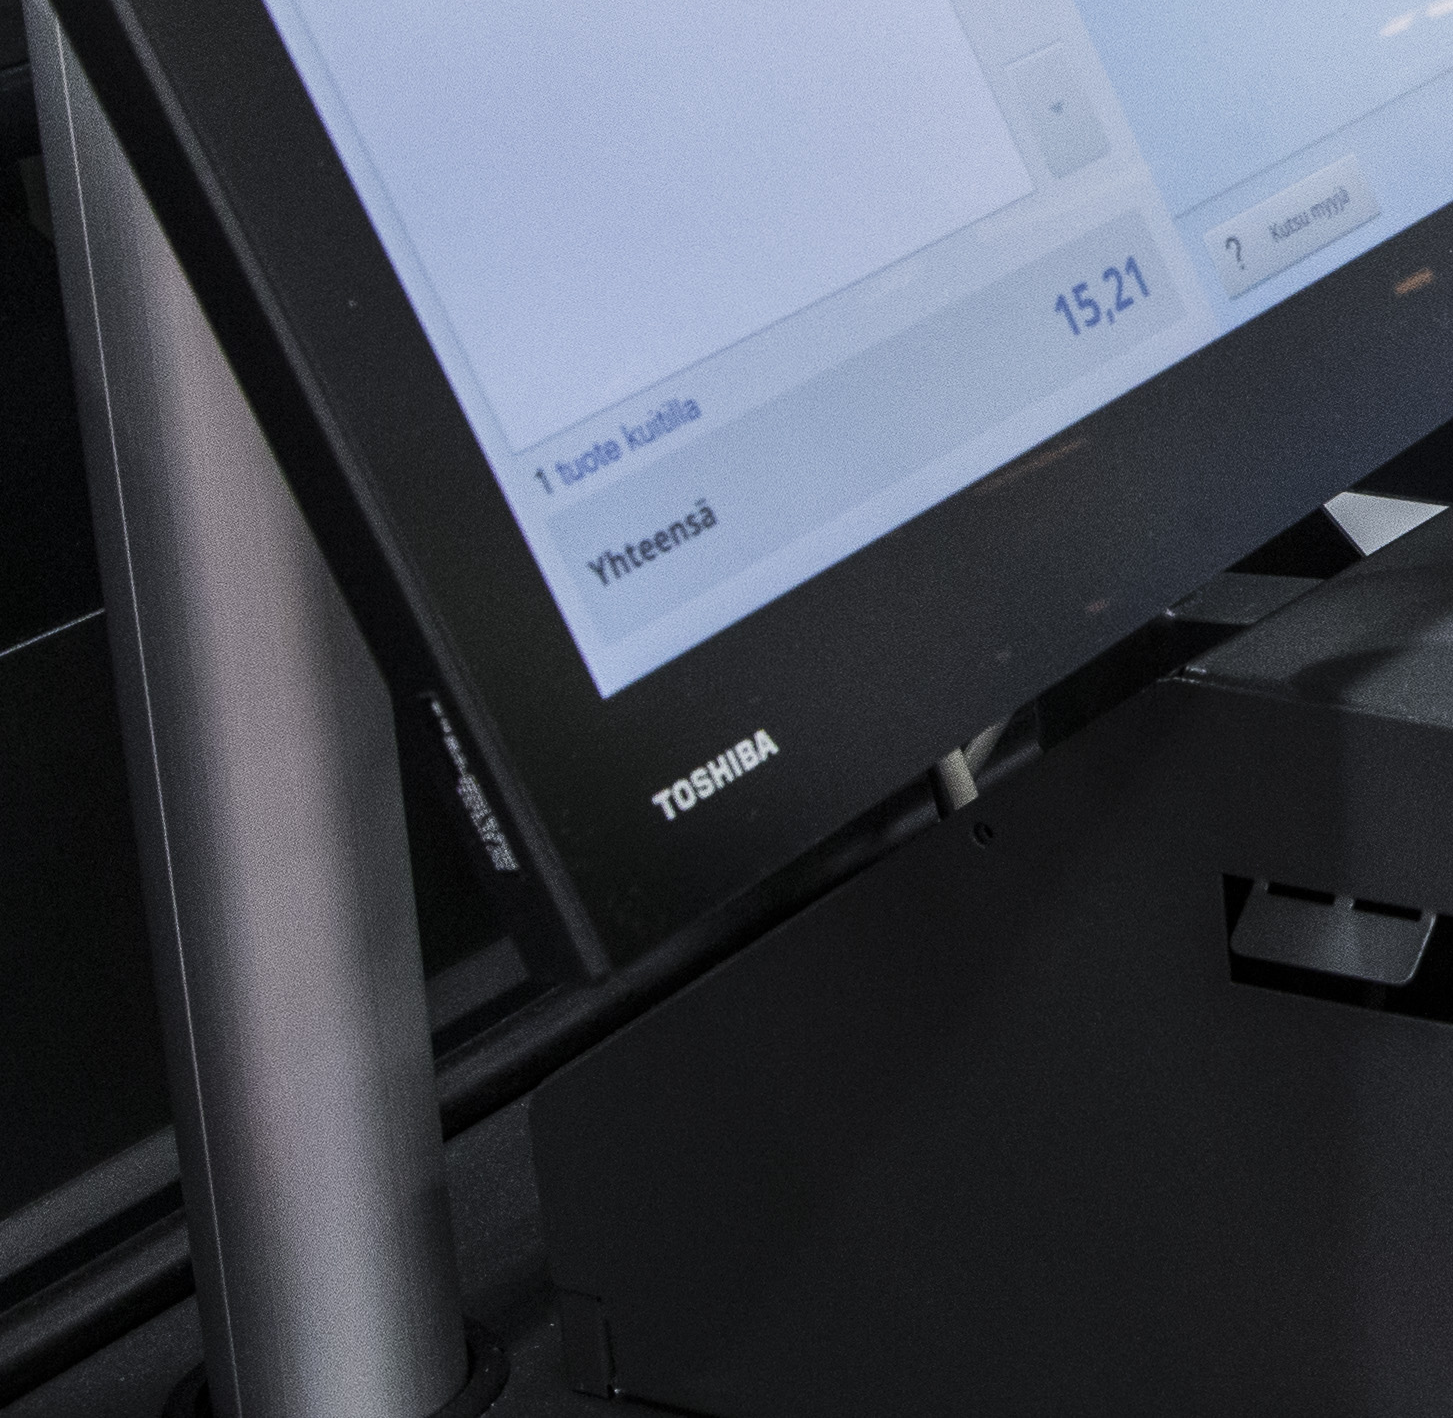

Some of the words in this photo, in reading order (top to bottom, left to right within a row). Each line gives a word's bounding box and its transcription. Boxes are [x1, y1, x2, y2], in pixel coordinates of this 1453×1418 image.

[1268, 210, 1311, 243] Kutsu
[1053, 255, 1152, 336] 15,21
[554, 433, 623, 488] tuote
[620, 393, 703, 450] kuitilla
[587, 497, 719, 587] Yhteensä
[651, 728, 780, 822] TOSHIBA
